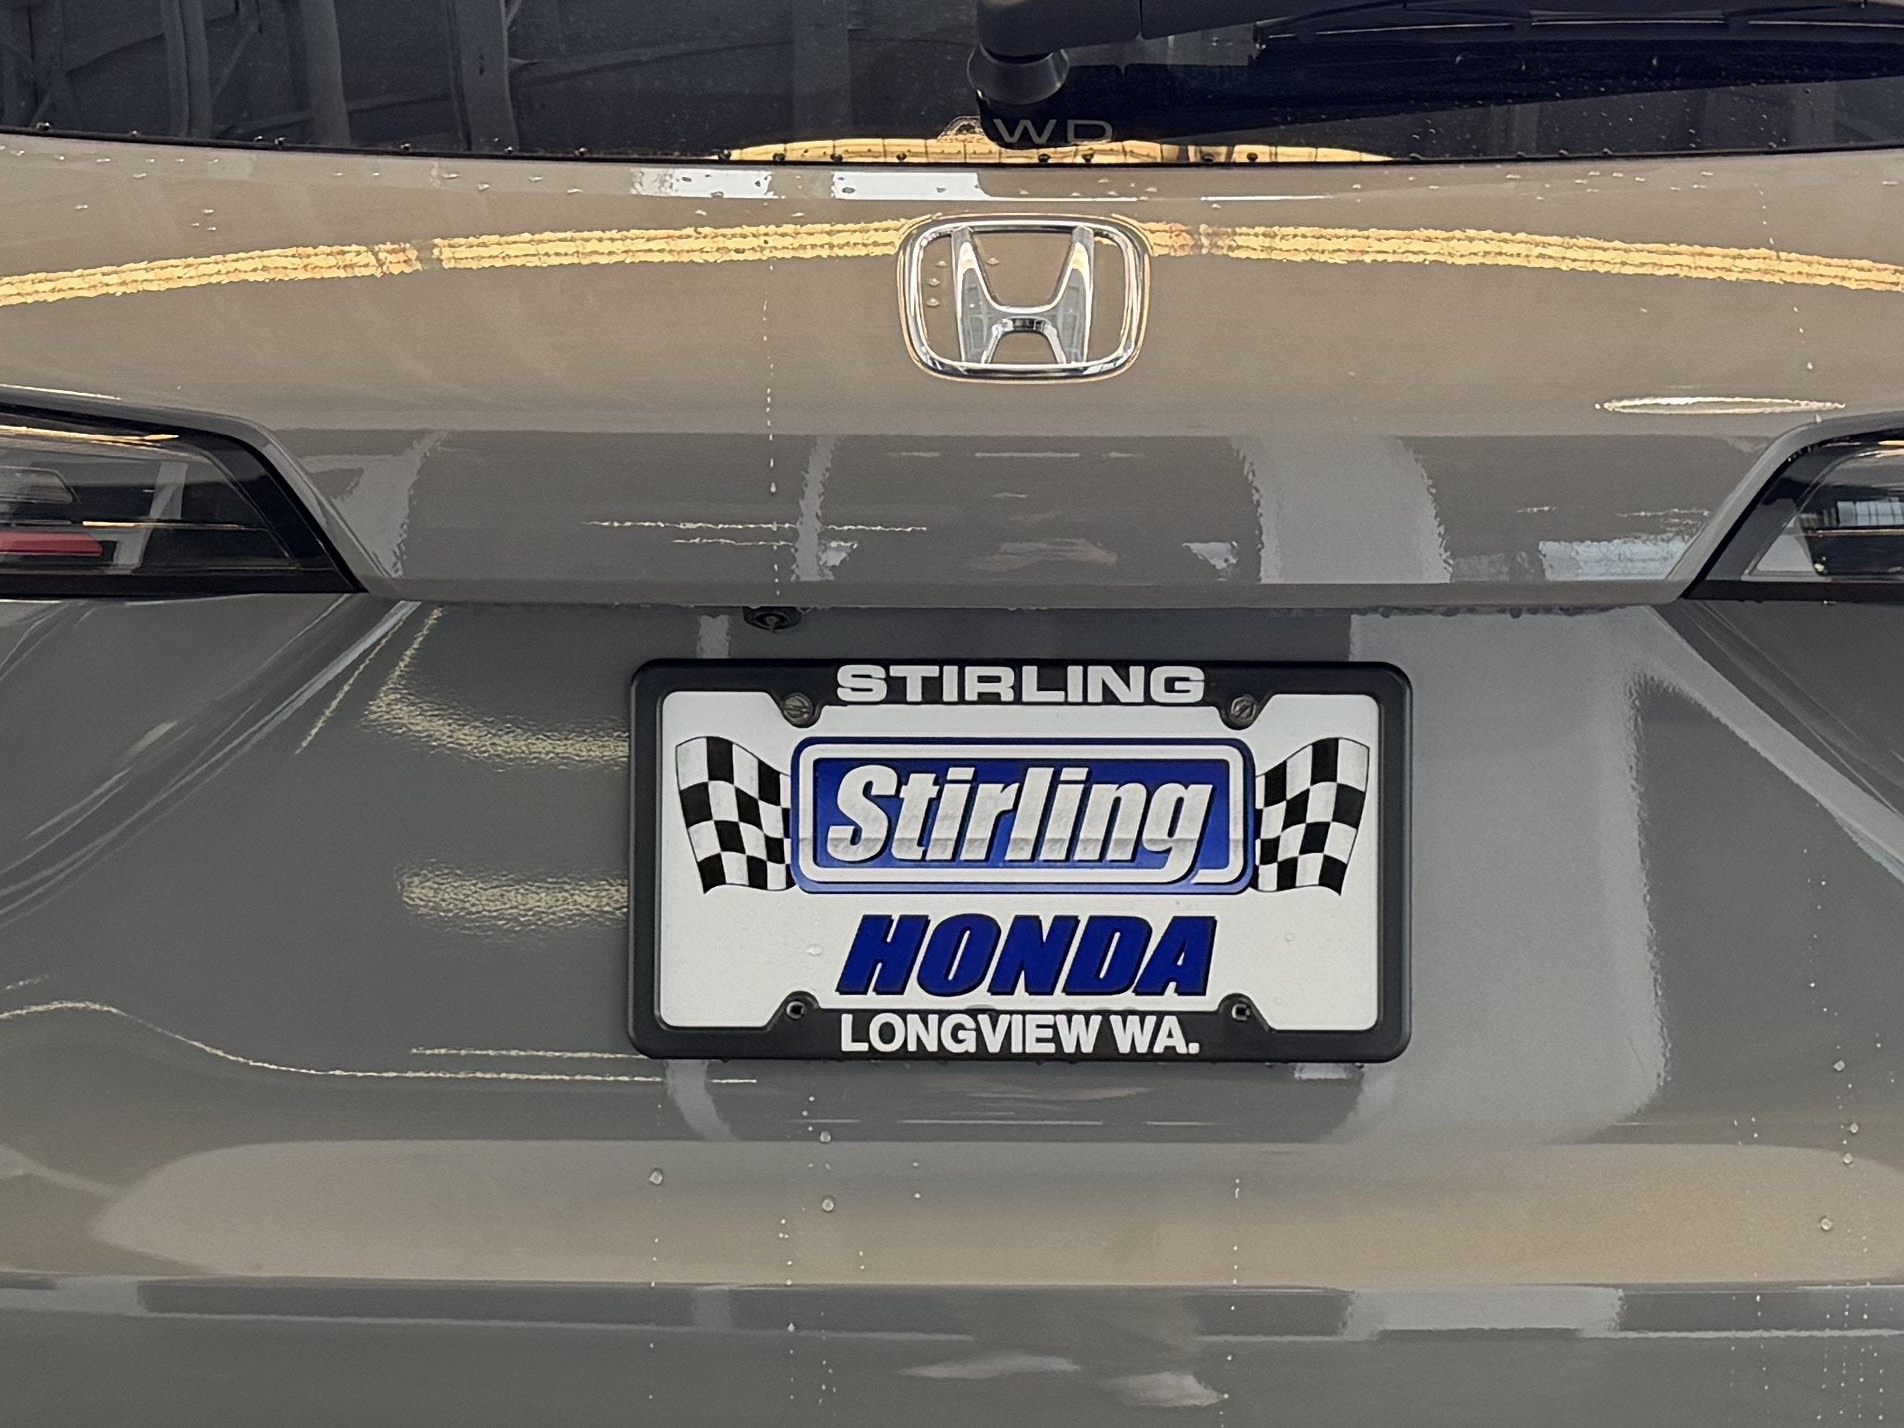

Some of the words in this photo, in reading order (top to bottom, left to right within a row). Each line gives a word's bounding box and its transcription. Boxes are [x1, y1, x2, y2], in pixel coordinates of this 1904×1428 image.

[837, 664, 1205, 704] STIRLING
[827, 764, 1214, 884] Stirling
[835, 913, 1218, 996] HONDA
[840, 1013, 1102, 1054] LONGVIEW
[1109, 1014, 1200, 1055] WA.
